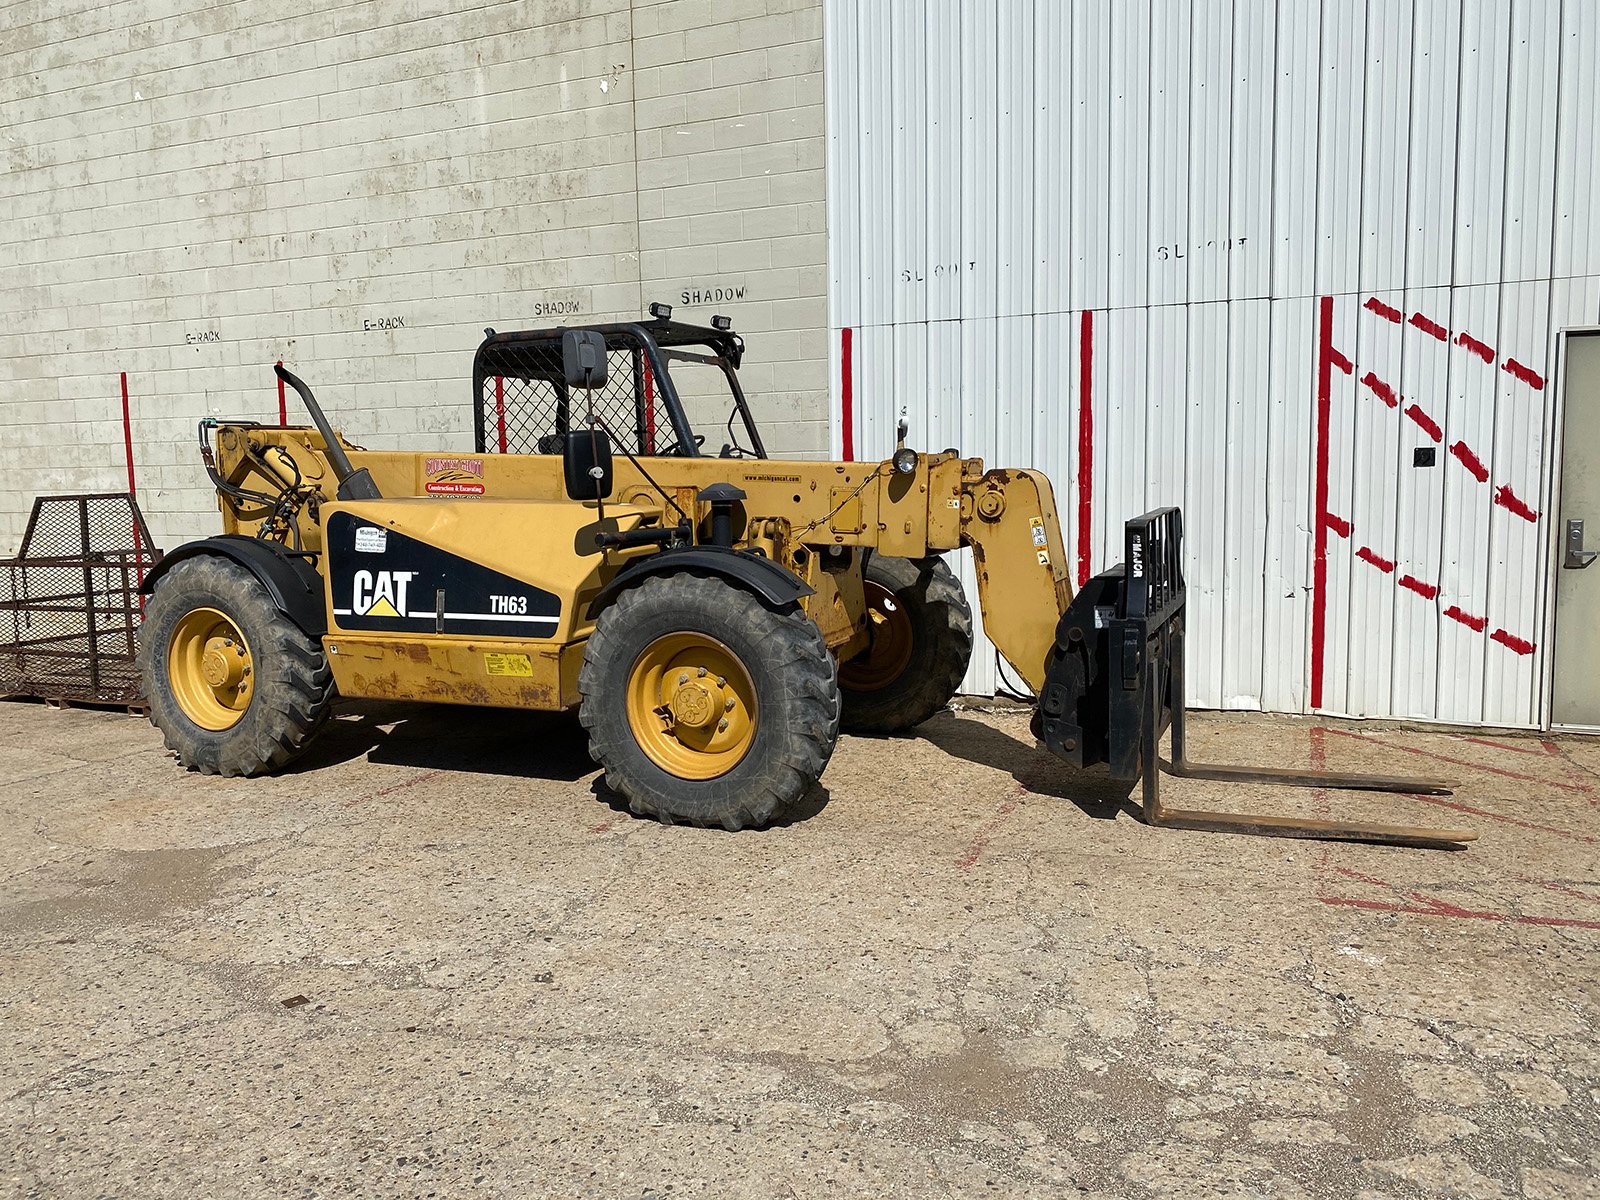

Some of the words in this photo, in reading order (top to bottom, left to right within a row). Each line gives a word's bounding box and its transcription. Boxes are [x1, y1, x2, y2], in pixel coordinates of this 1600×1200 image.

[681, 286, 748, 305] SHADOW
[534, 300, 580, 316] SHADOW
[363, 316, 406, 331] E-RACK
[185, 330, 220, 345] E-RACK
[1132, 543, 1144, 578] MAJOR
[352, 569, 413, 617] CAT
[489, 595, 528, 615] TH63
